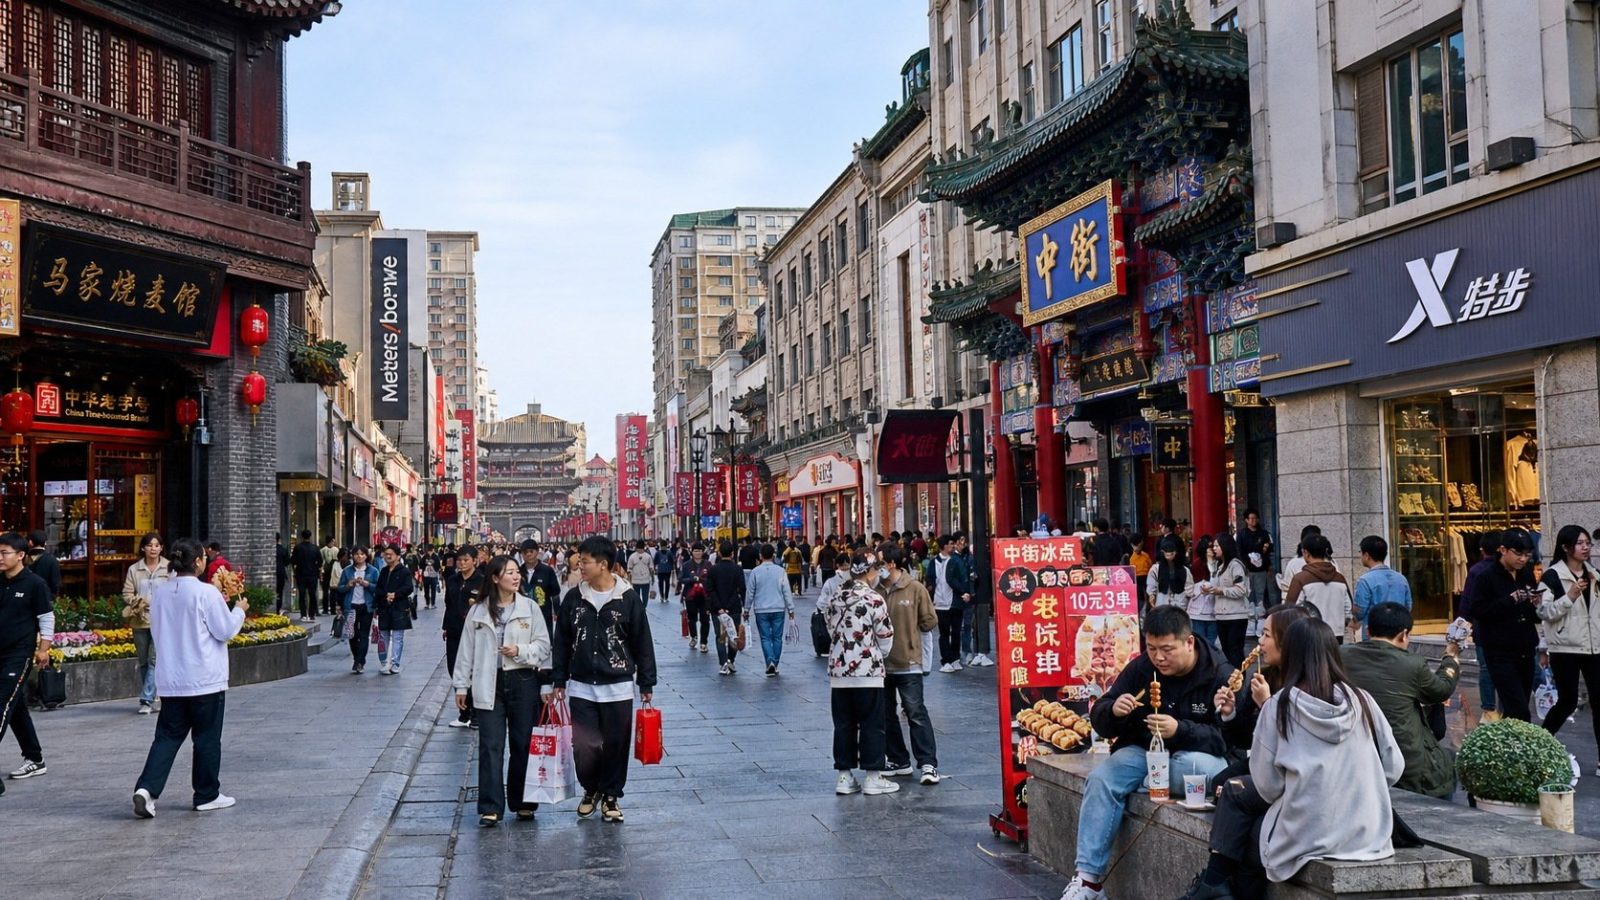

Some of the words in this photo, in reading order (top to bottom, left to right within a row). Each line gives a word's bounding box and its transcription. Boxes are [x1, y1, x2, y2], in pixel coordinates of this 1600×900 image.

[1035, 218, 1100, 300] 中街
[43, 257, 201, 318] 马家烧麦馆
[1386, 248, 1460, 344] X
[1456, 267, 1532, 324] 特步
[65, 389, 150, 413] 中华老字号
[1164, 436, 1181, 459] 中
[1004, 543, 1076, 564] 中街冰点
[1070, 590, 1131, 609] 10元3串
